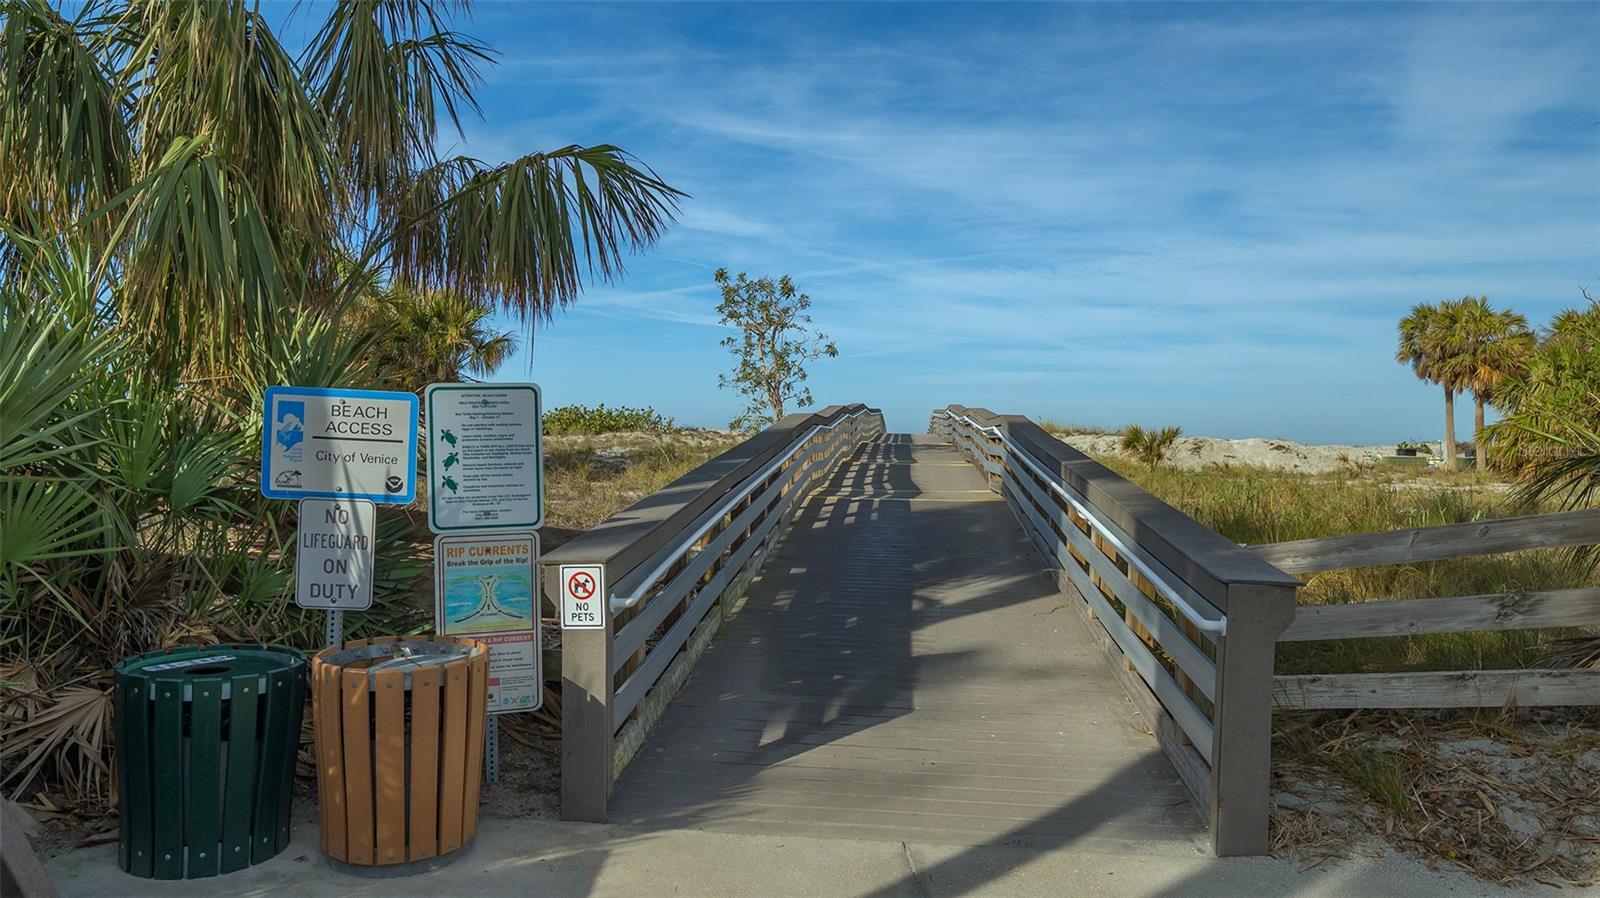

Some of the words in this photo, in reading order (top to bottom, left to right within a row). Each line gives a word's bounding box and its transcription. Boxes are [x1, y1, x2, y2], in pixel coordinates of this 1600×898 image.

[331, 404, 388, 419] BEACH
[325, 421, 393, 436] ACCESS
[315, 450, 341, 464] City
[343, 452, 356, 463] of
[360, 453, 399, 465] Venice
[325, 508, 349, 525] NO
[303, 533, 369, 551] LIFEGUARD
[447, 547, 465, 558] RIP
[469, 544, 529, 557] CURRENTS
[323, 558, 348, 575] ON
[480, 558, 494, 567] Grip
[503, 557, 514, 565] the
[515, 557, 529, 565] Rip!
[310, 583, 358, 600] DUTY
[575, 602, 590, 611] NO
[571, 612, 595, 622] PETS
